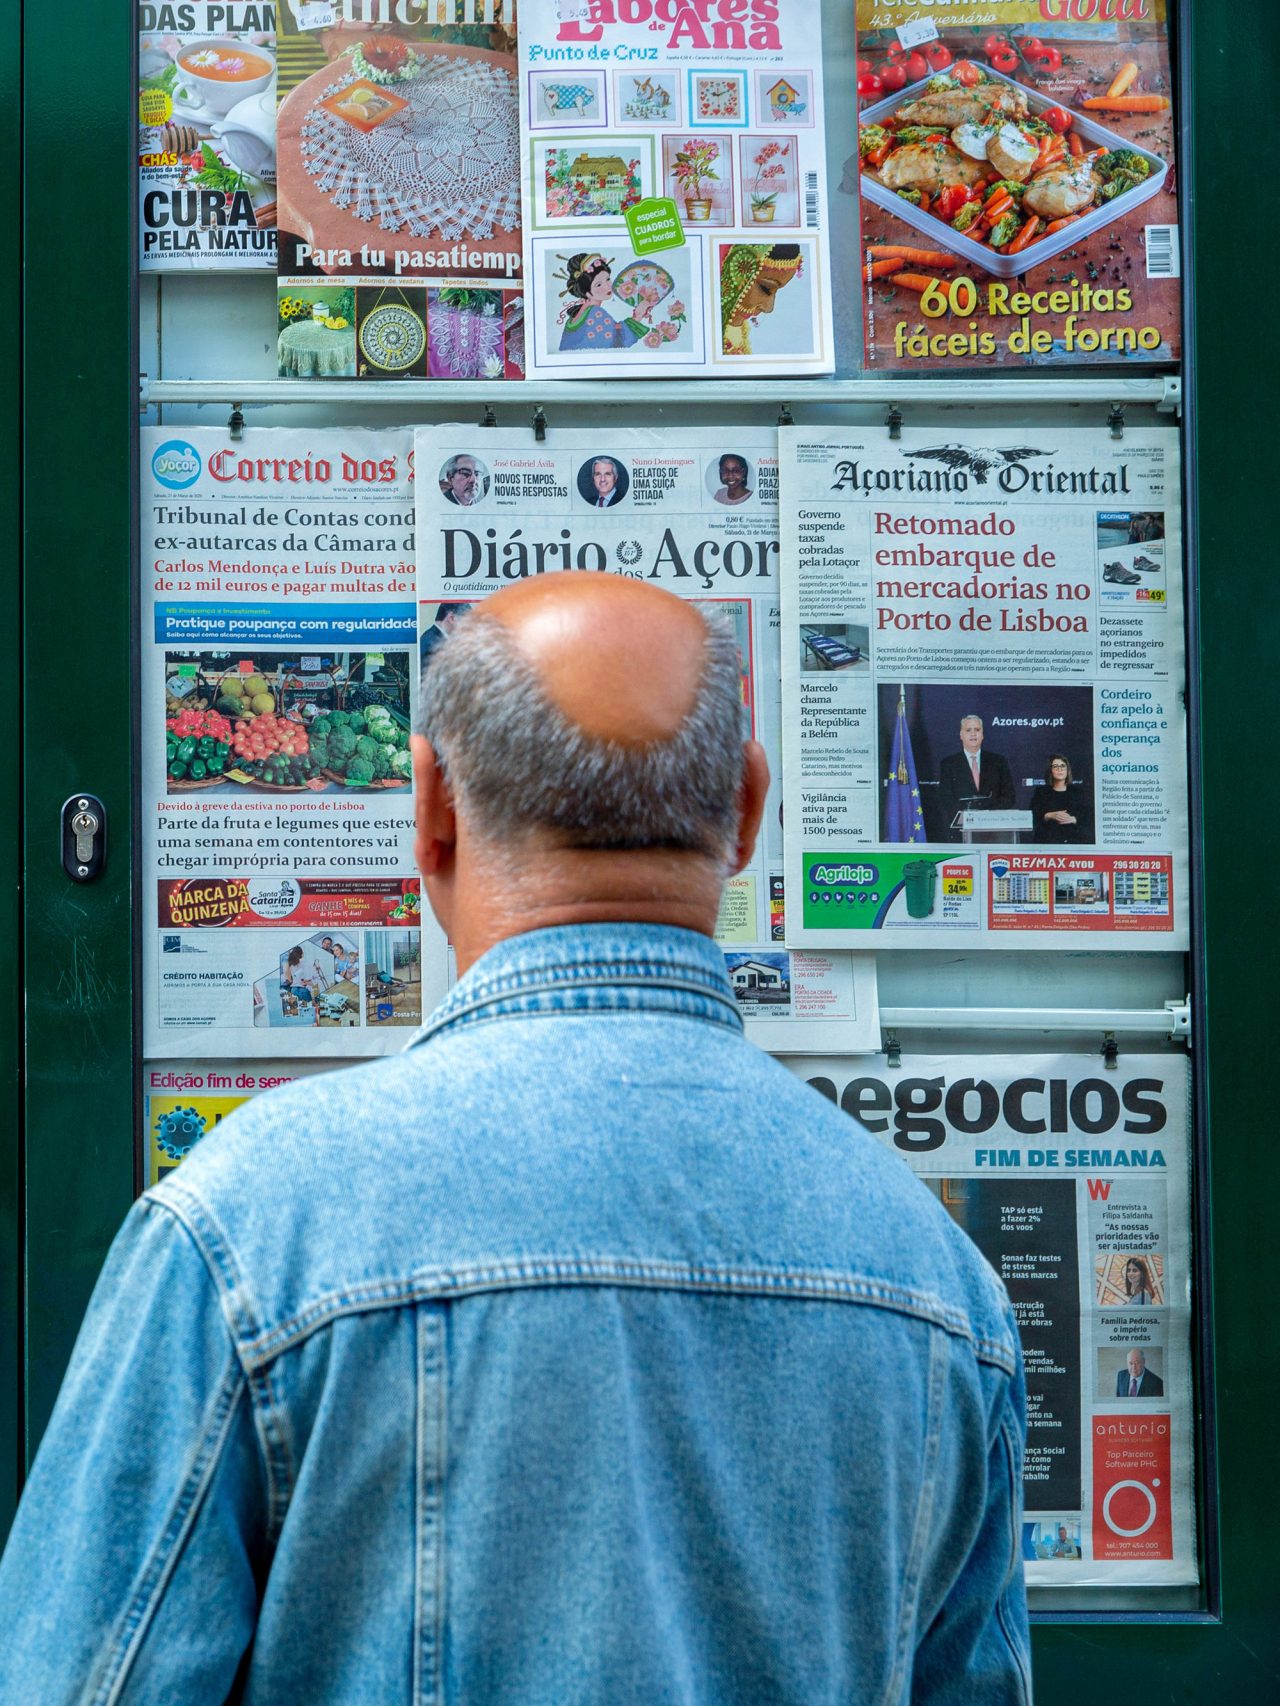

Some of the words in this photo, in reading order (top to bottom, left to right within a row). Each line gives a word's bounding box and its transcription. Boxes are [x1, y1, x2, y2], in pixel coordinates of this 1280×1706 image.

[529, 45, 585, 62] Punto
[592, 46, 609, 61] de
[614, 46, 658, 61] Cruz
[142, 152, 177, 166] CHÁS
[144, 189, 257, 229] CURA
[634, 218, 676, 235] CUADROS
[144, 231, 202, 251] PELA
[296, 244, 353, 268] Para
[361, 247, 386, 268] tu
[919, 276, 977, 320] 60
[989, 281, 1132, 316] Receitas
[895, 321, 996, 359] fáceis
[1007, 318, 1054, 354] de
[1063, 318, 1162, 352] forno
[208, 450, 330, 484] Correio
[341, 452, 396, 482] dos
[494, 474, 520, 485] NOVOS
[522, 474, 557, 486] TEMPOS,
[830, 462, 969, 497] Açoriano
[998, 463, 1132, 495] Oriental
[494, 486, 520, 496] NOVAS
[522, 486, 568, 497] RESPOSTAS
[154, 506, 246, 525] Tribunal
[252, 508, 278, 526] de
[284, 509, 358, 526] Contas
[798, 510, 841, 519] Governo
[798, 521, 845, 533] suspende
[875, 512, 1015, 537] Retomado
[798, 534, 825, 543] taxas
[441, 528, 607, 579] Diário
[798, 545, 844, 555] cobradas
[875, 543, 1017, 573] embarque
[1023, 545, 1056, 568] de
[799, 557, 819, 568] pela
[822, 557, 860, 568] Lotaçor
[876, 576, 1049, 601] mercadorias
[1056, 583, 1090, 601] no
[877, 608, 951, 631] Porto
[959, 609, 992, 632] de
[1000, 609, 1088, 633] Lisboa
[1101, 689, 1152, 701] Cordeiro
[992, 716, 1064, 728] Azores.gov.pt
[158, 803, 192, 811] Devido
[195, 803, 200, 811] à
[202, 804, 228, 813] greve
[231, 803, 242, 811] da
[245, 803, 272, 811] estiva
[290, 803, 316, 813] porto
[319, 802, 331, 811] de
[333, 802, 365, 811] Lisboa
[158, 855, 209, 869] chegar
[213, 854, 289, 869] imprópria
[293, 856, 325, 869] para
[330, 855, 399, 866] consumo
[1012, 856, 1066, 869] RE/MAX
[1069, 859, 1095, 869] 4YOU
[816, 866, 873, 884] Agriloja
[151, 1073, 204, 1091] Edição
[207, 1073, 232, 1088] fim
[235, 1074, 255, 1088] de
[975, 1150, 1020, 1167] FIM
[1028, 1150, 1059, 1167] DE
[1064, 1149, 1166, 1167] SEMANA
[1129, 1318, 1160, 1326] Pedrosa,
[1097, 1422, 1167, 1435] anturio
